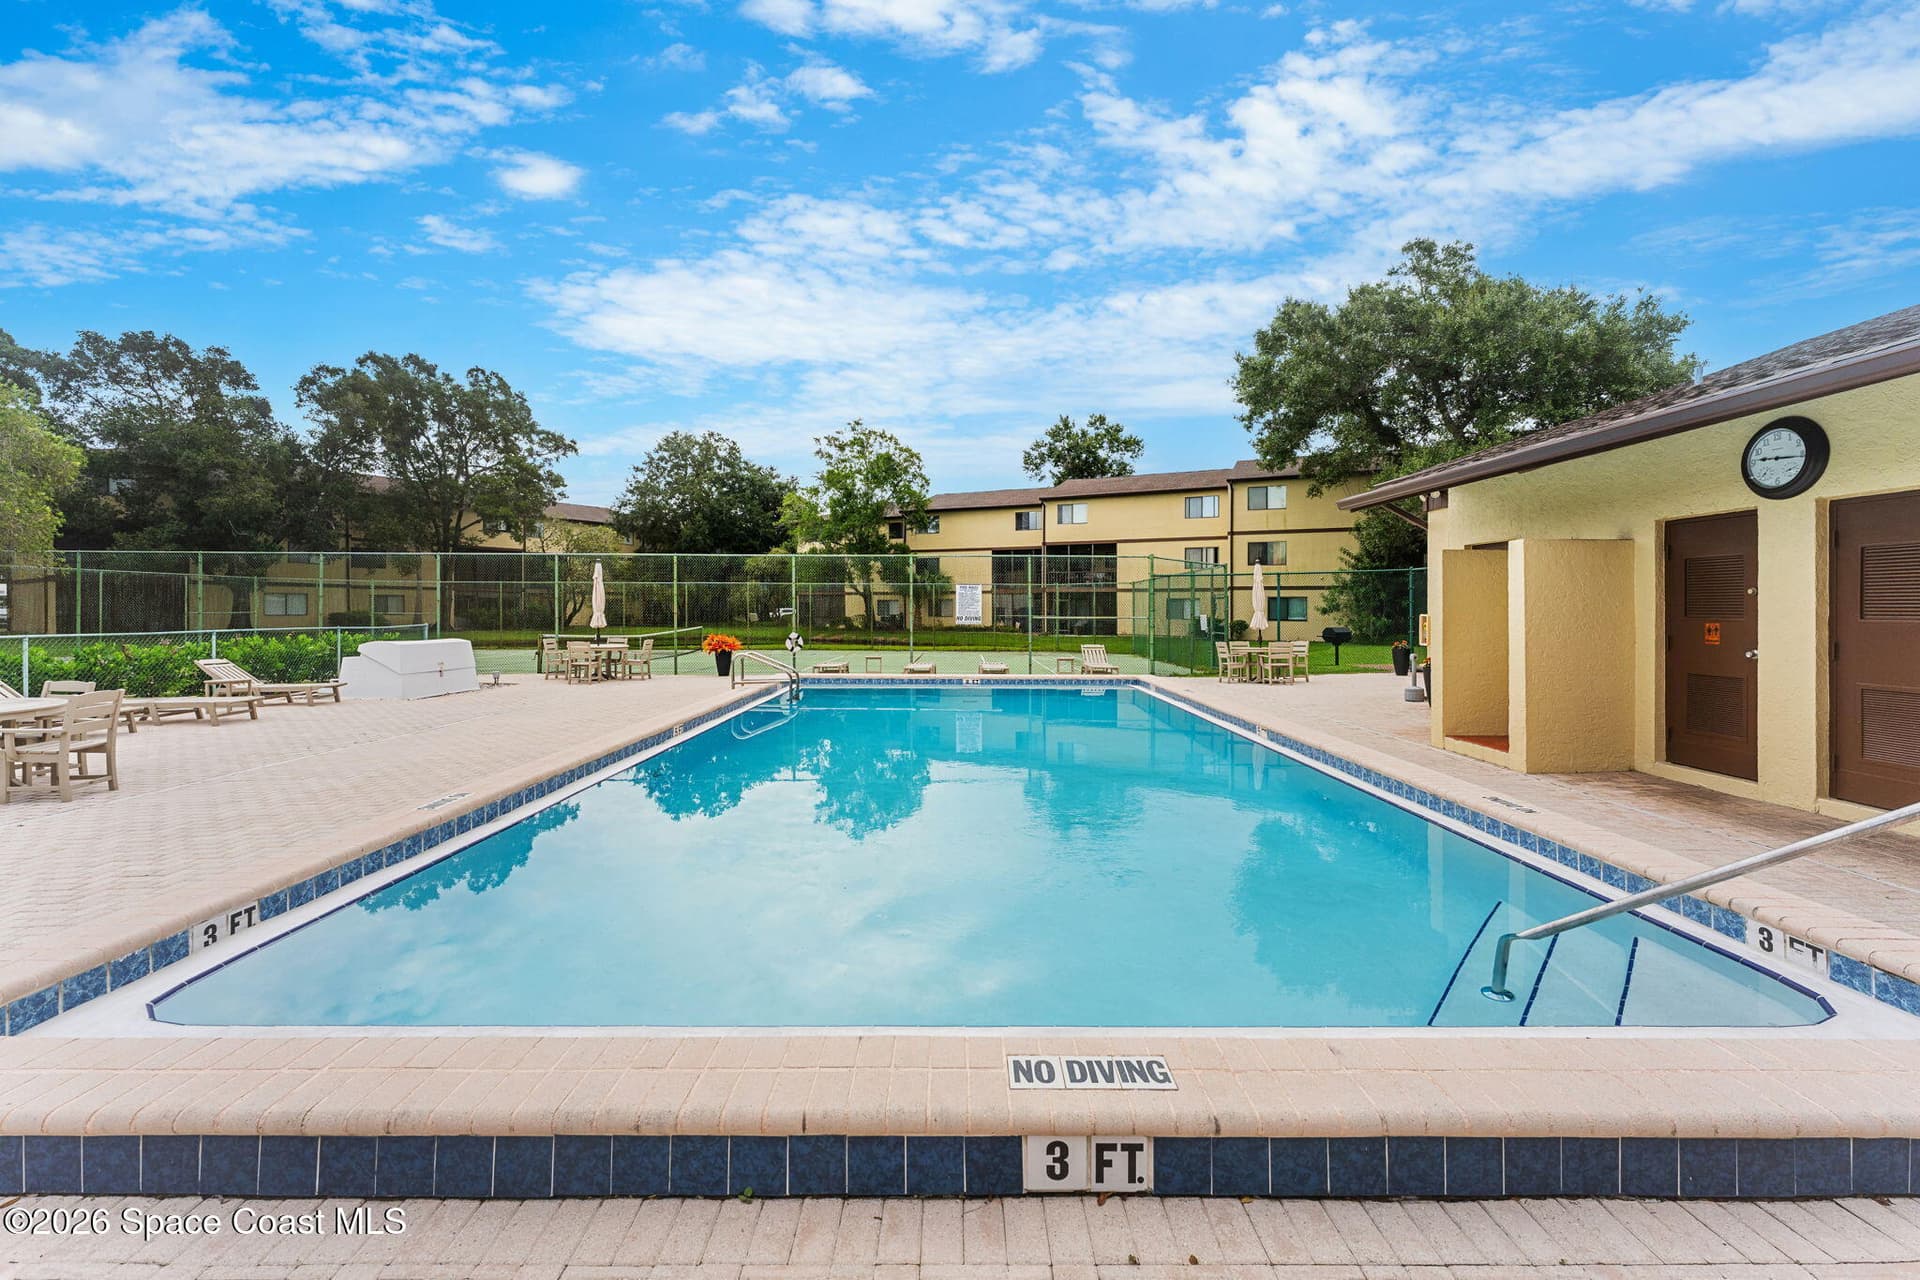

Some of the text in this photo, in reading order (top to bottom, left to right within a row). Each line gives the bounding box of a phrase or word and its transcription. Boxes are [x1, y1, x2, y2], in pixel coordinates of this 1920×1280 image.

[203, 923, 218, 948] 3
[1758, 926, 1774, 953] 3
[1012, 1059, 1172, 1084] NO DIVING
[1045, 1140, 1145, 1184] 3 FT.
